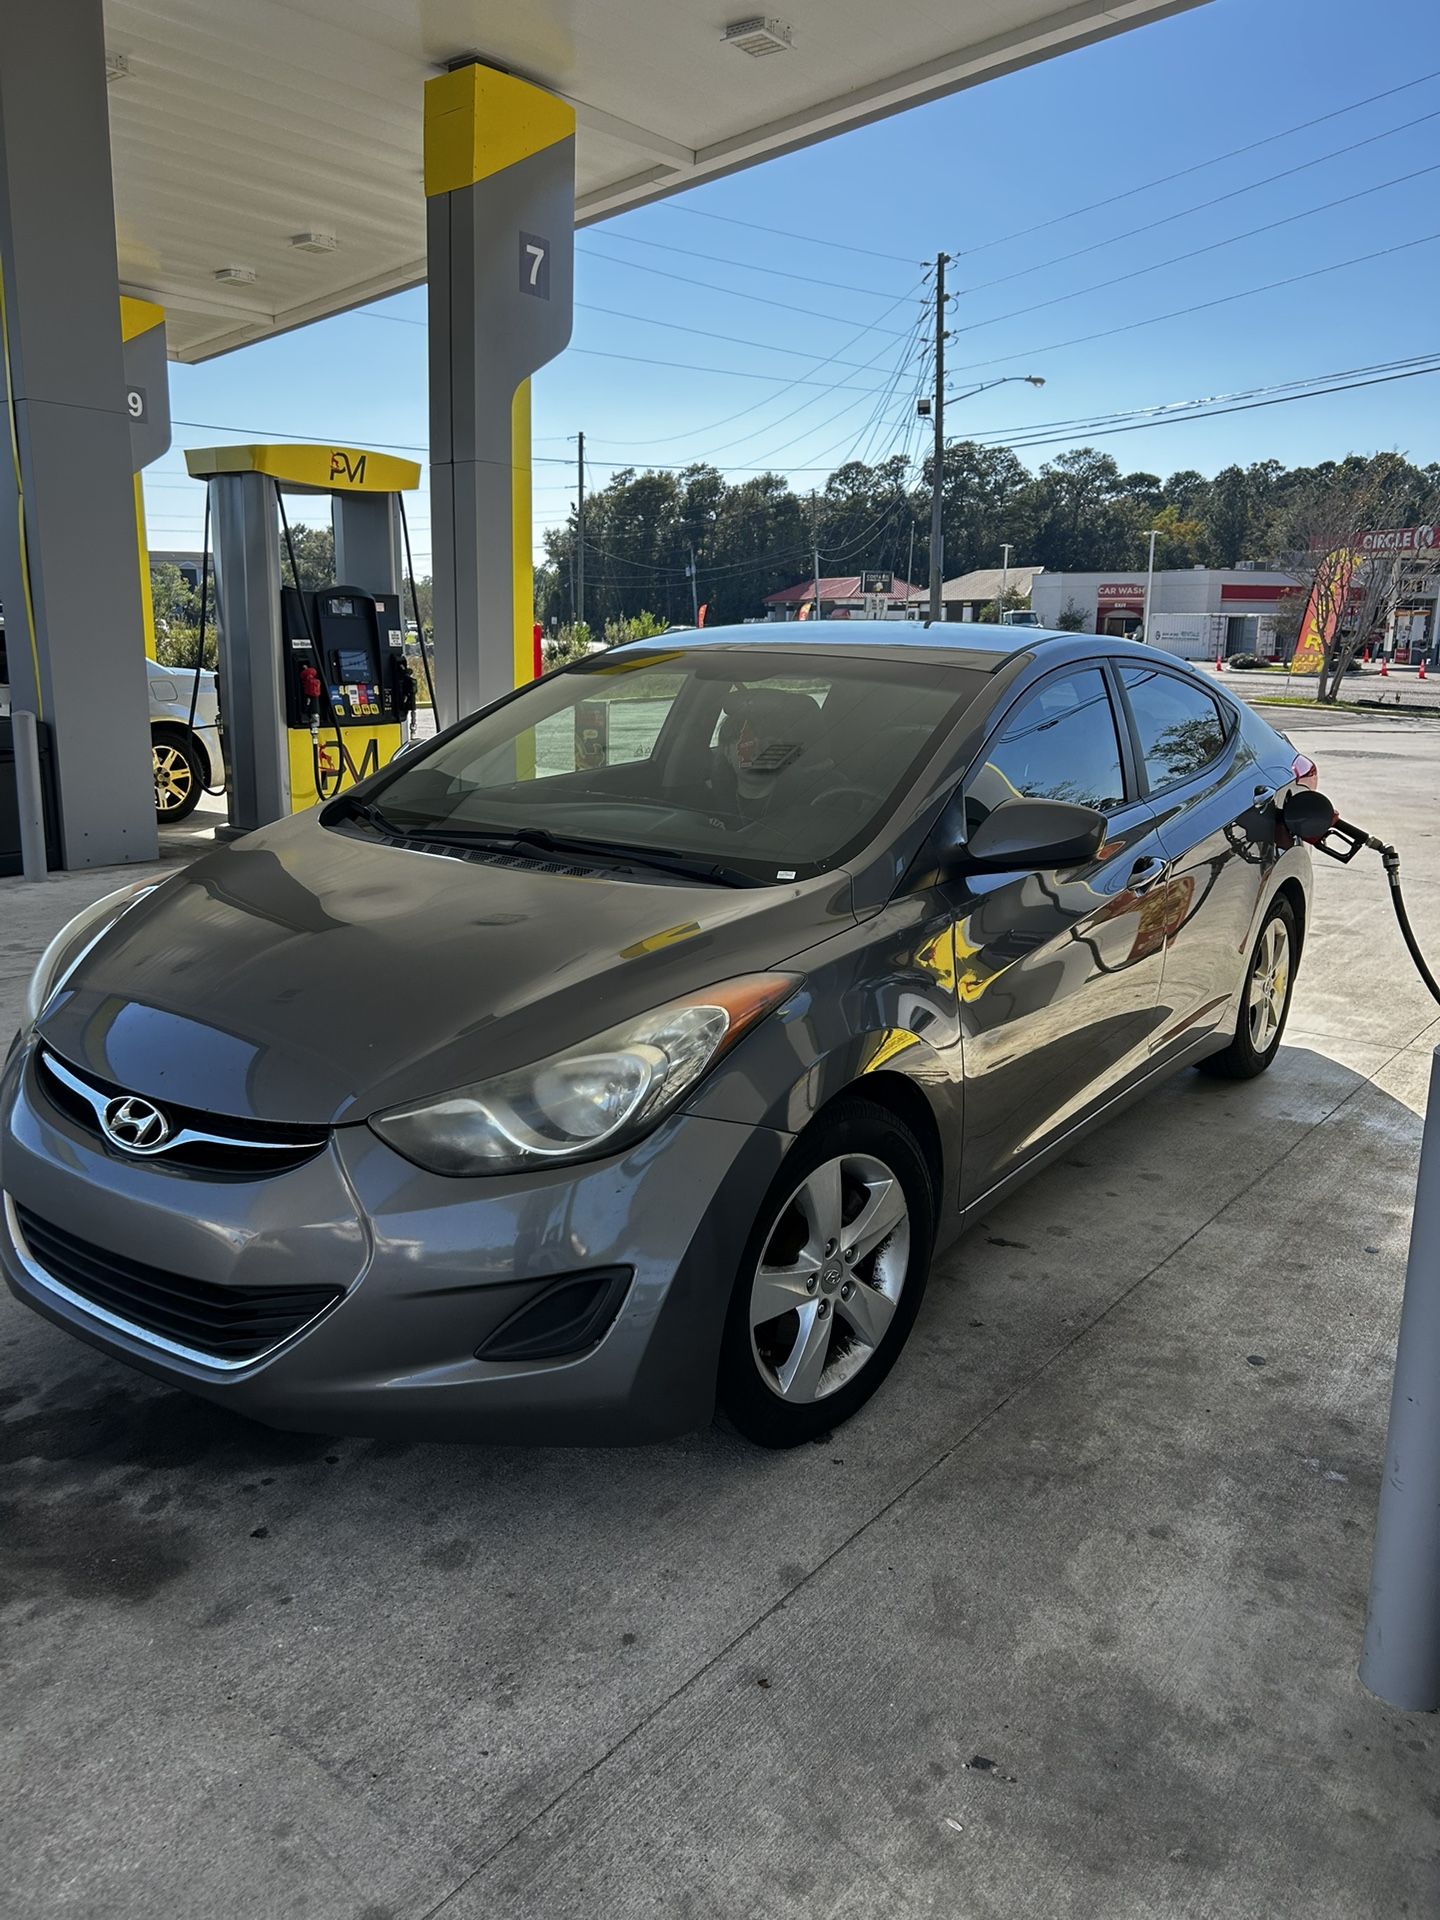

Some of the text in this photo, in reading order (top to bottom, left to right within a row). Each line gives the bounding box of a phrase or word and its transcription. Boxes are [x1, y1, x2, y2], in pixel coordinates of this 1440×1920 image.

[526, 244, 545, 286] 7
[127, 391, 144, 417] 9
[1362, 531, 1412, 549] CIRCLE
[1098, 586, 1145, 595] CAR WASH
